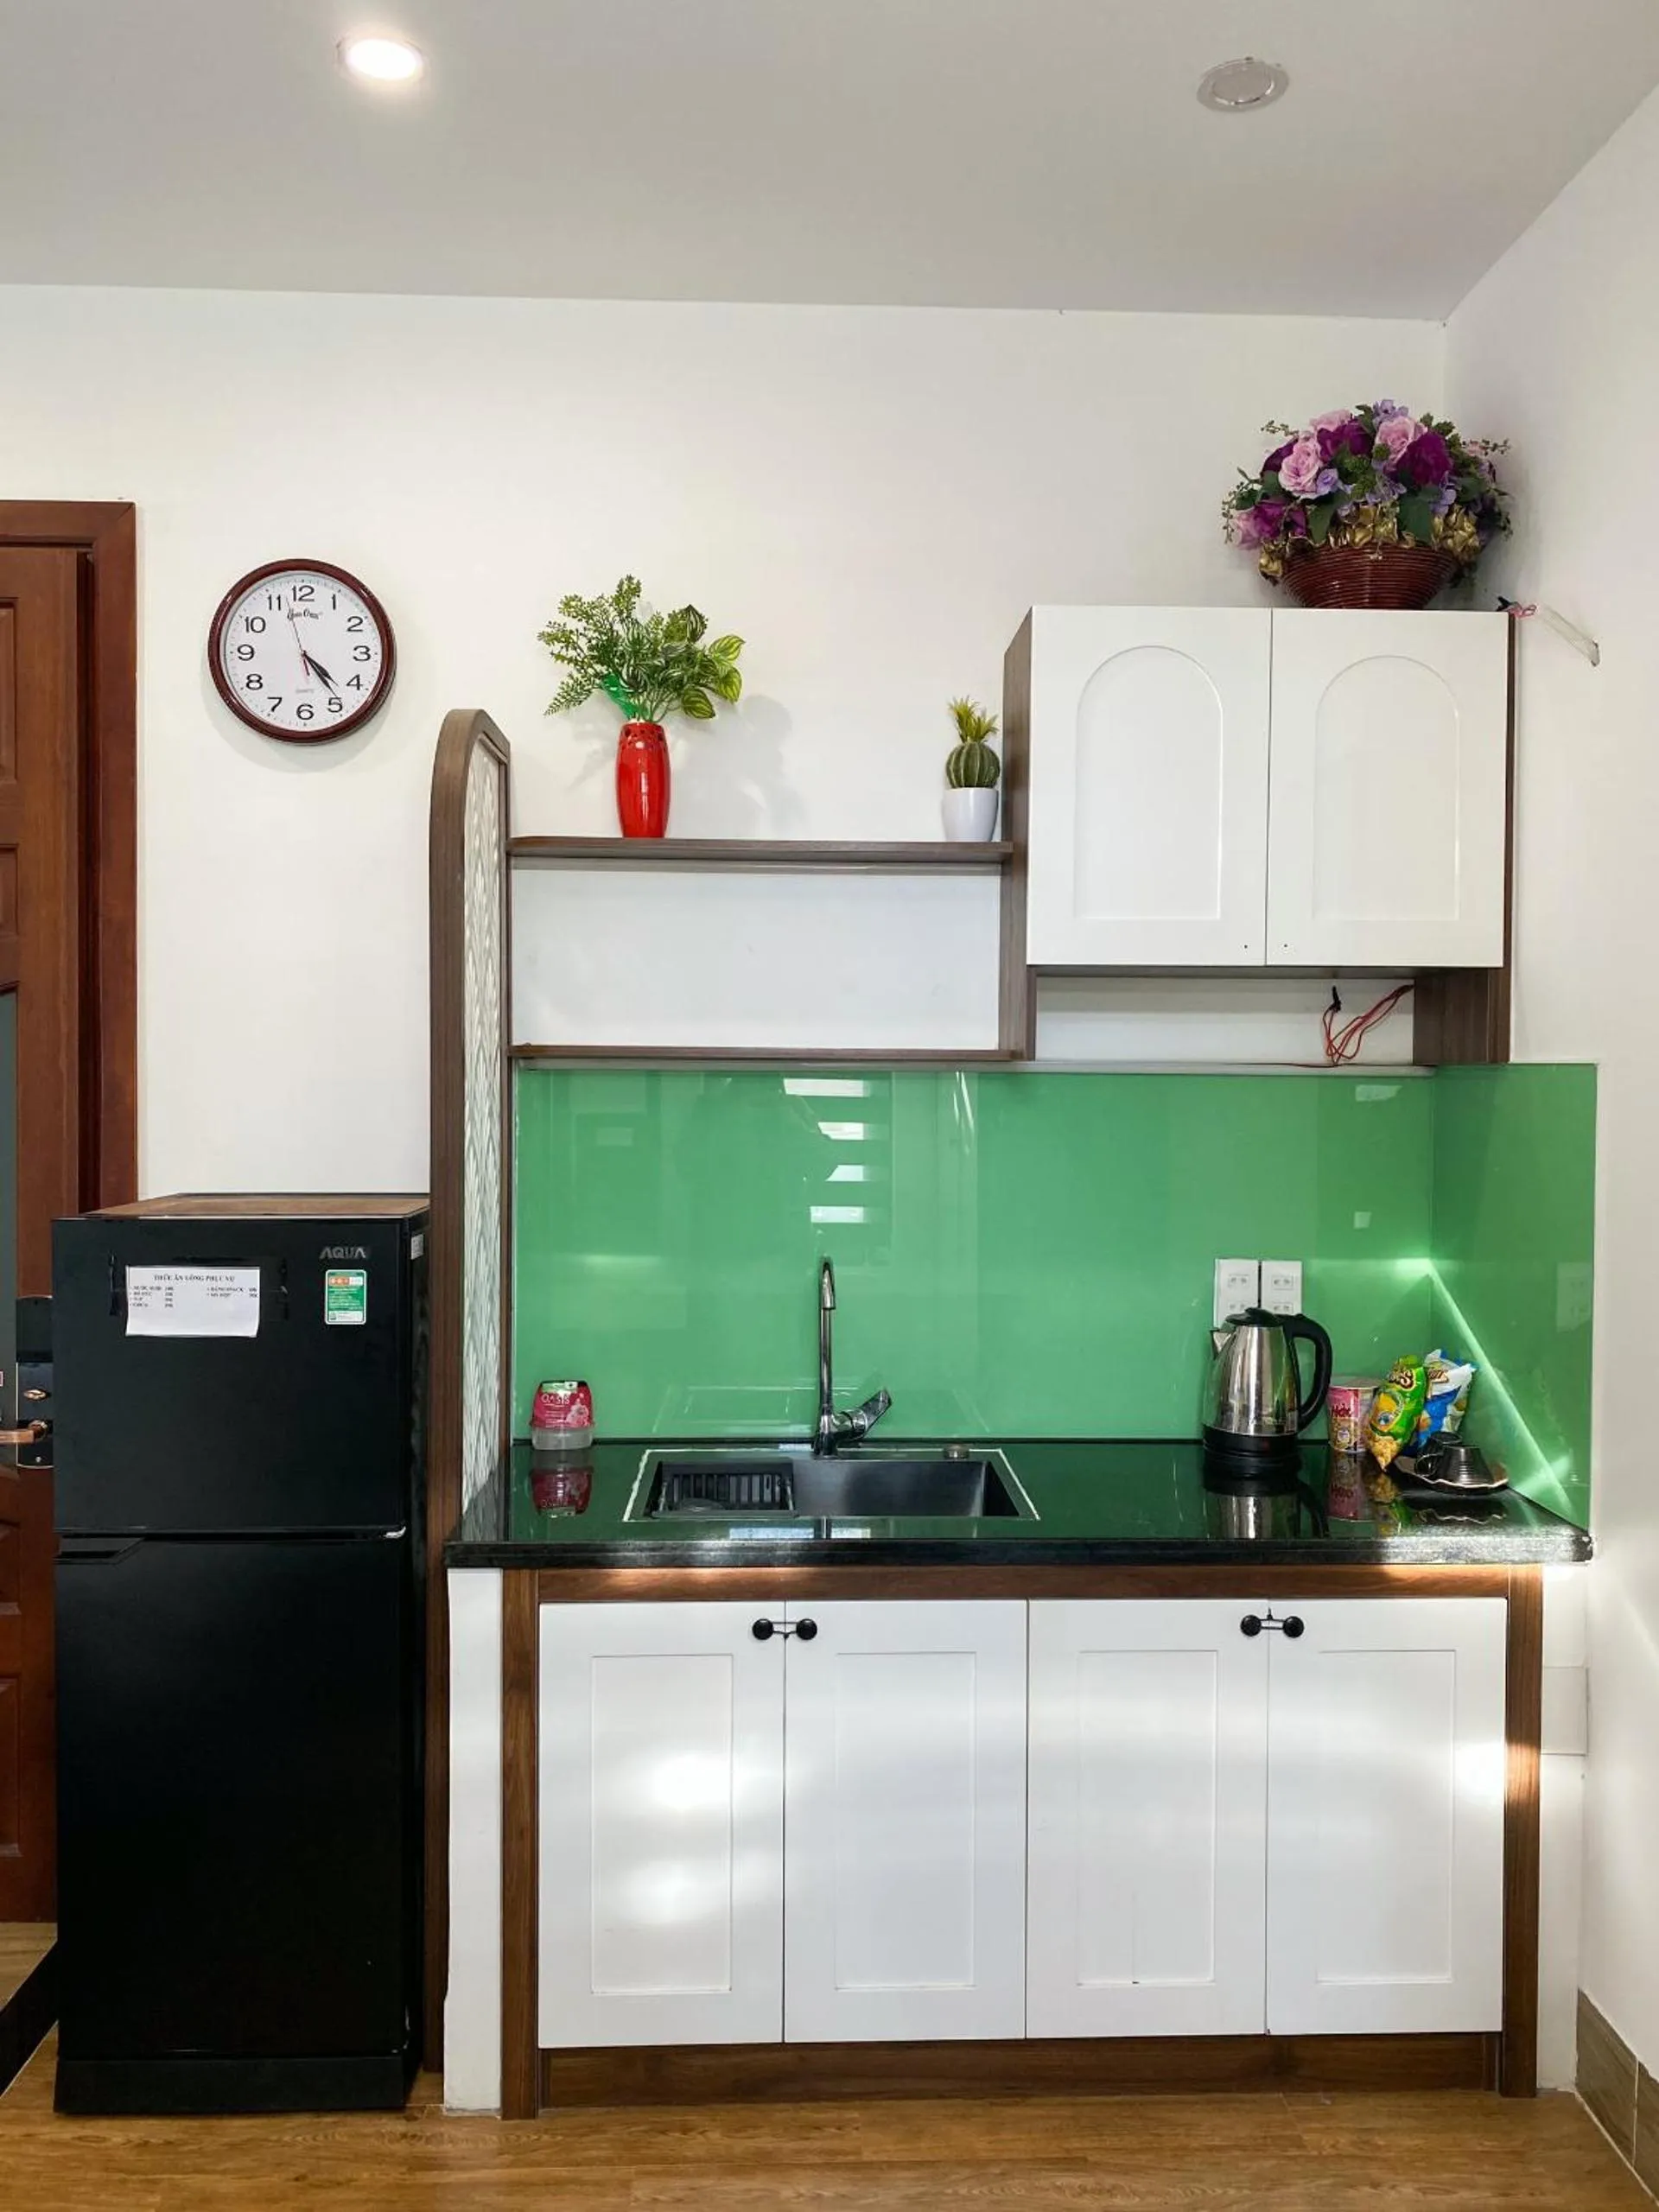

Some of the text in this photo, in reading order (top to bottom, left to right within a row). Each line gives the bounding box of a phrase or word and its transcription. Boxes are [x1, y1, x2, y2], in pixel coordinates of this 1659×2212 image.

[292, 585, 315, 601] 12
[267, 594, 281, 611] 11
[331, 594, 336, 610] 1
[245, 616, 266, 633] 10
[346, 616, 364, 632] 2
[237, 645, 254, 661] 9
[353, 645, 371, 662] 3
[245, 673, 263, 690] 8
[346, 674, 363, 690] 4
[267, 696, 283, 713] 7
[296, 703, 314, 721] 6
[327, 697, 343, 713] 5
[320, 1246, 366, 1259] AQUA
